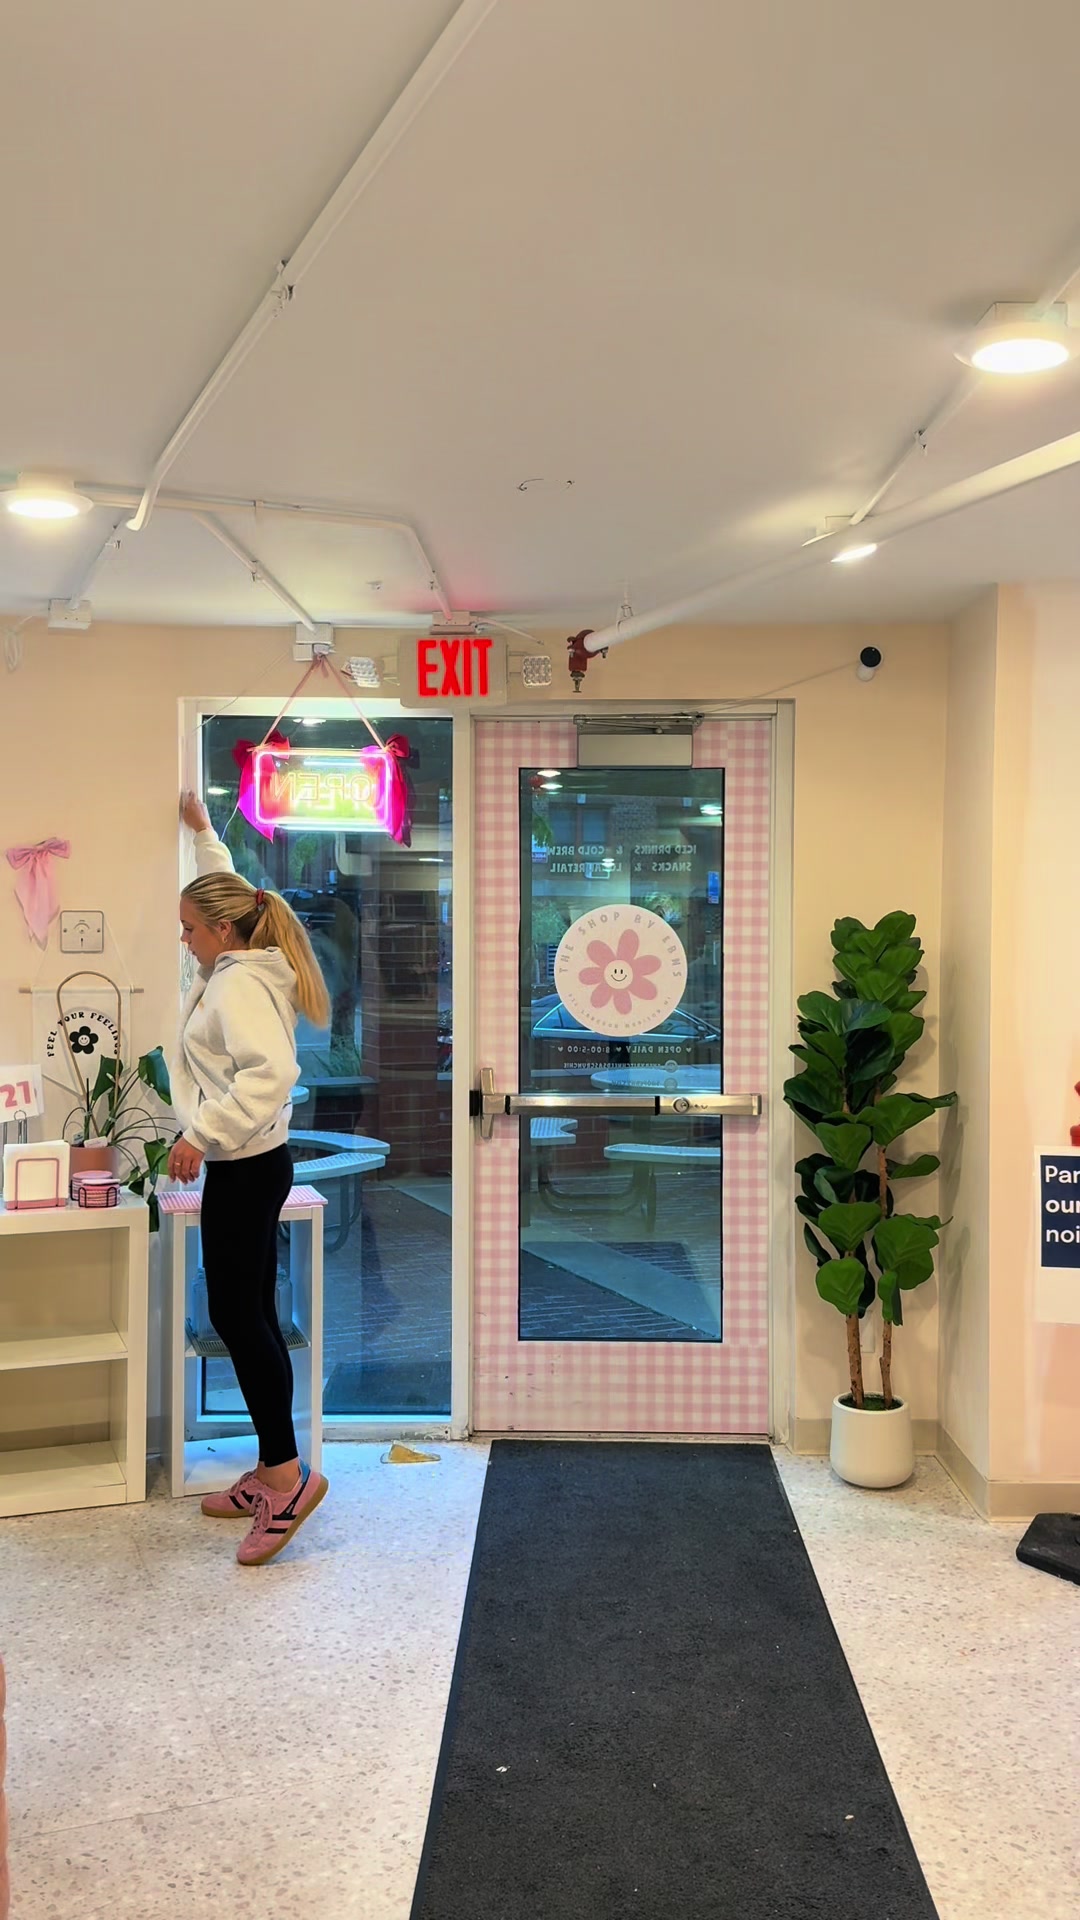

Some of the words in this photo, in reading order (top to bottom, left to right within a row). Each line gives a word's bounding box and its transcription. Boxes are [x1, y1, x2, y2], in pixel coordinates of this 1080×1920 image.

[416, 638, 493, 697] EXIT
[559, 944, 575, 973] THE
[578, 912, 620, 936] SHOP
[634, 914, 655, 929] BY
[46, 1030, 58, 1058] FEEL
[57, 1011, 85, 1027] YOUR
